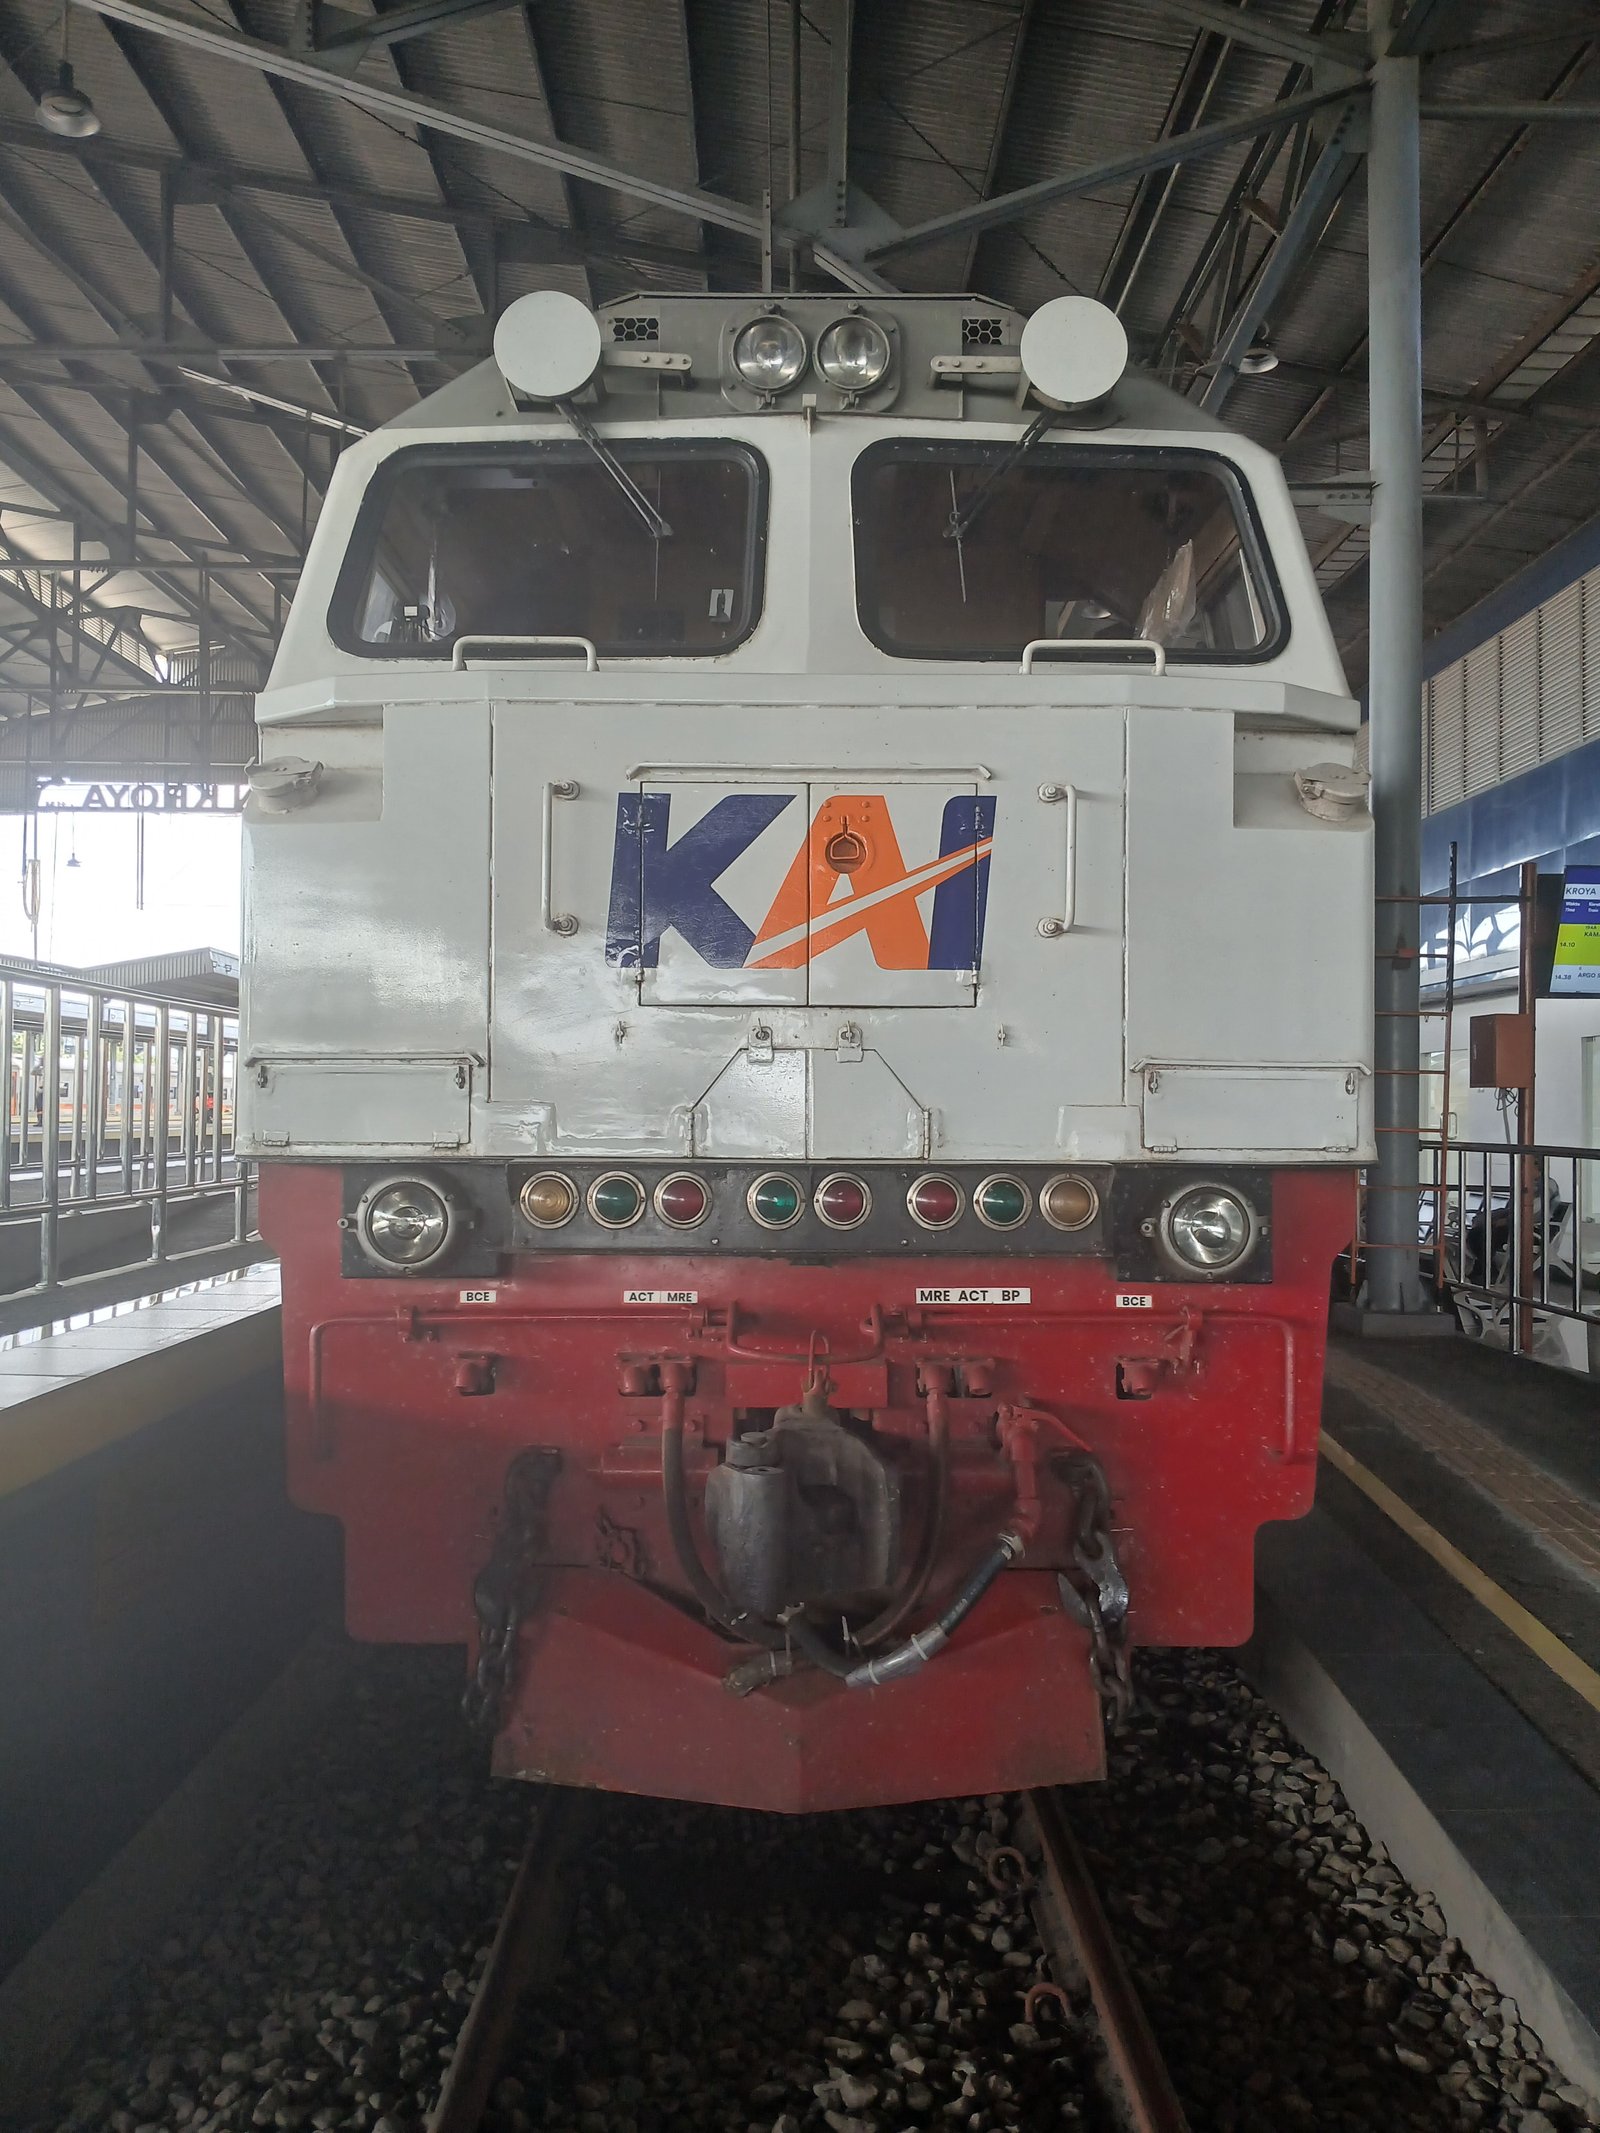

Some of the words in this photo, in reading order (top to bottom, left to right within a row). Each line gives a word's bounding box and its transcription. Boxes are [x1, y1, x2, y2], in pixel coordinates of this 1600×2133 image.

[605, 792, 997, 970] KAI
[1565, 887, 1597, 896] KROYA
[466, 1291, 490, 1302] BCE
[629, 1292, 654, 1302] ACT
[667, 1292, 693, 1302] MRE
[920, 1290, 950, 1302] MRE
[958, 1290, 989, 1302] ACT
[1001, 1290, 1020, 1301] BP
[1122, 1296, 1146, 1307] BCE
